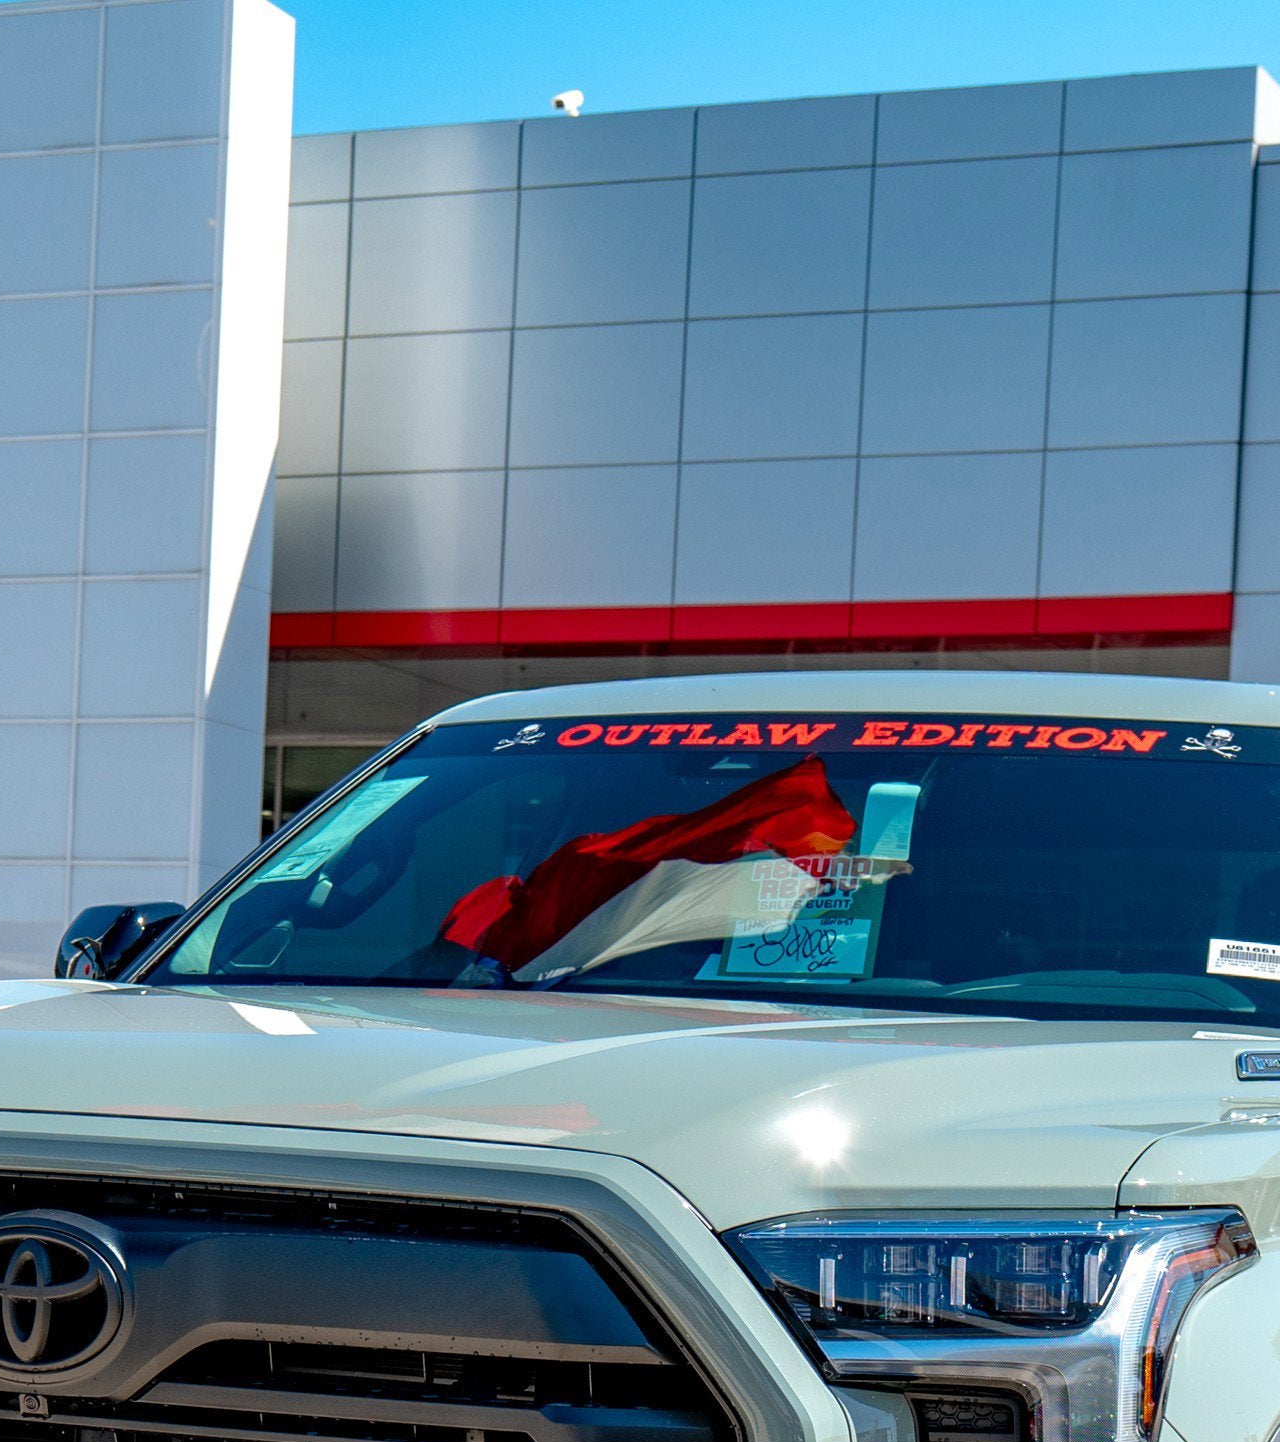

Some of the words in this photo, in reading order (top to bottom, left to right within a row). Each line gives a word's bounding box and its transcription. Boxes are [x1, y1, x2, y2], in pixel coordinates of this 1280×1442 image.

[556, 720, 837, 748] OUTLAW
[852, 719, 1168, 754] EDITION
[761, 877, 860, 900] READY
[759, 899, 803, 912] SALES
[805, 898, 853, 910] EVENT
